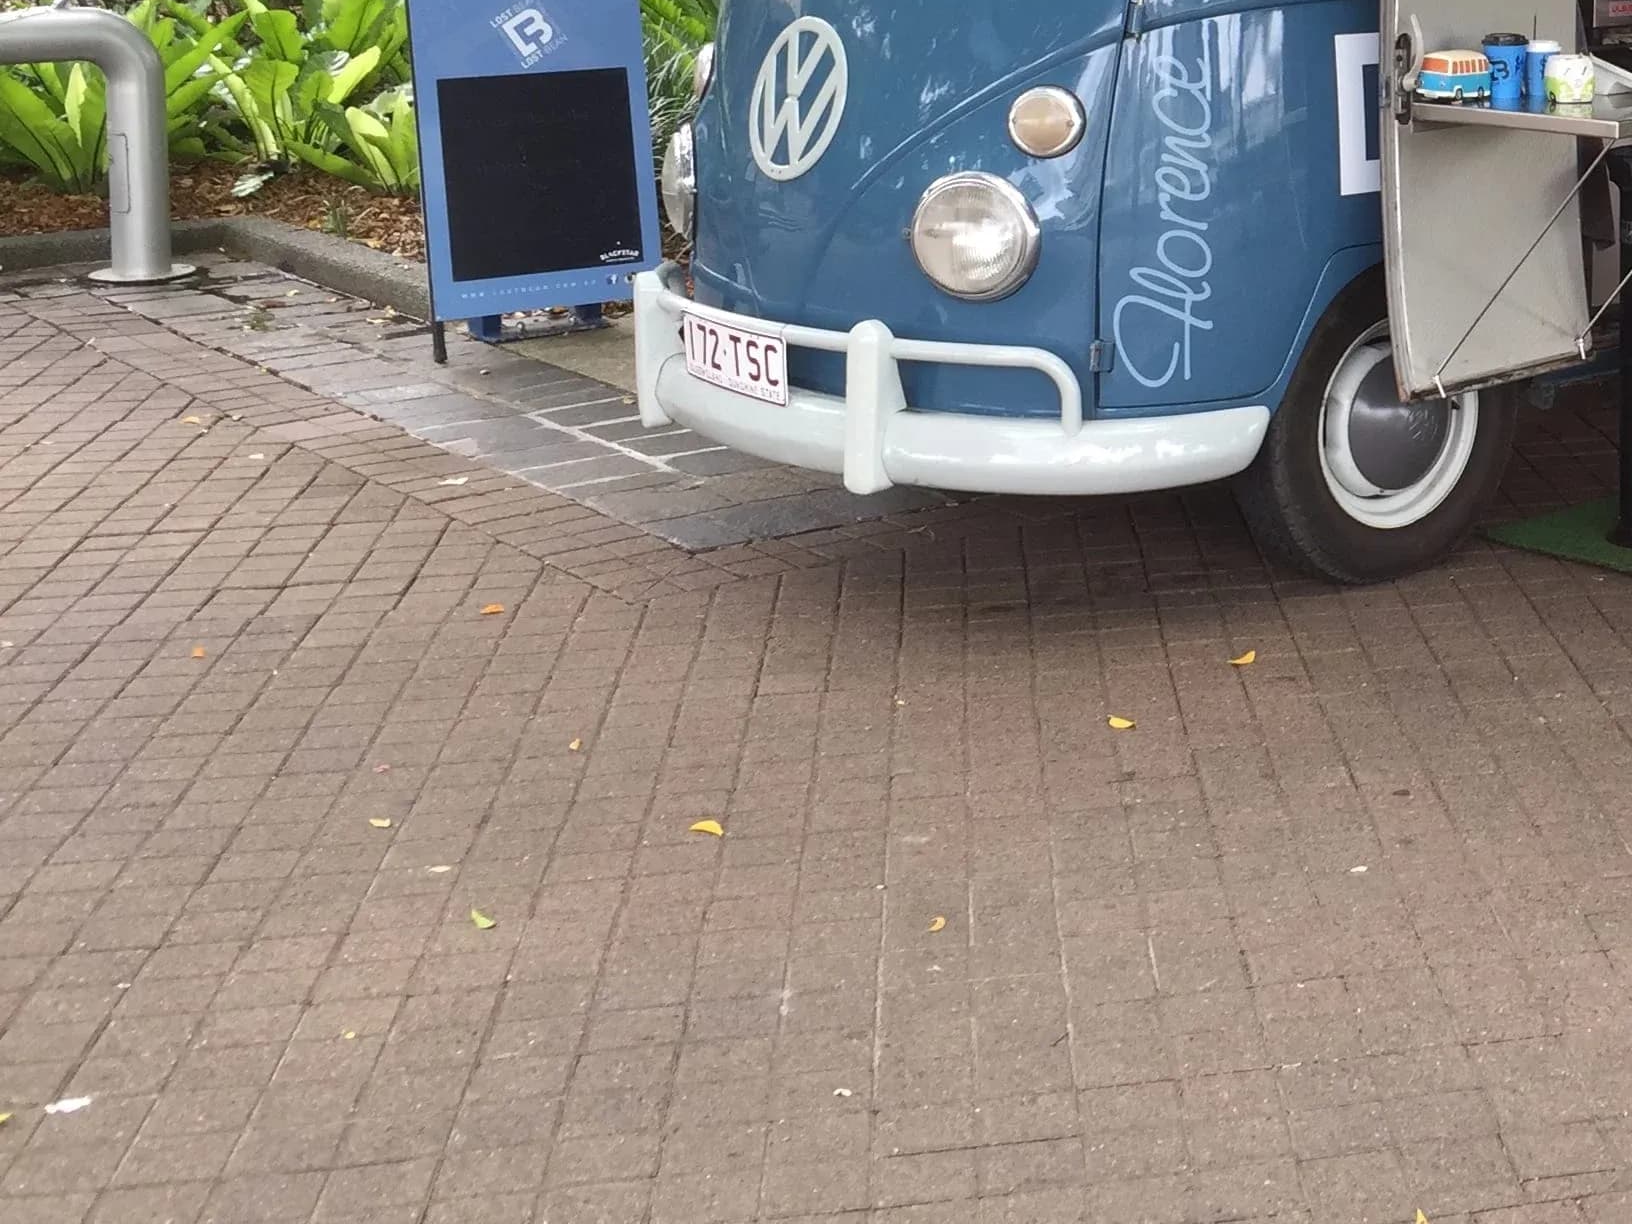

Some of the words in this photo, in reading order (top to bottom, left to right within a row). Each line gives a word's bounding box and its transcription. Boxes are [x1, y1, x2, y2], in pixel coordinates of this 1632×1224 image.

[489, 8, 513, 28] LOST
[520, 49, 544, 69] LOST
[1113, 54, 1213, 387] Florence
